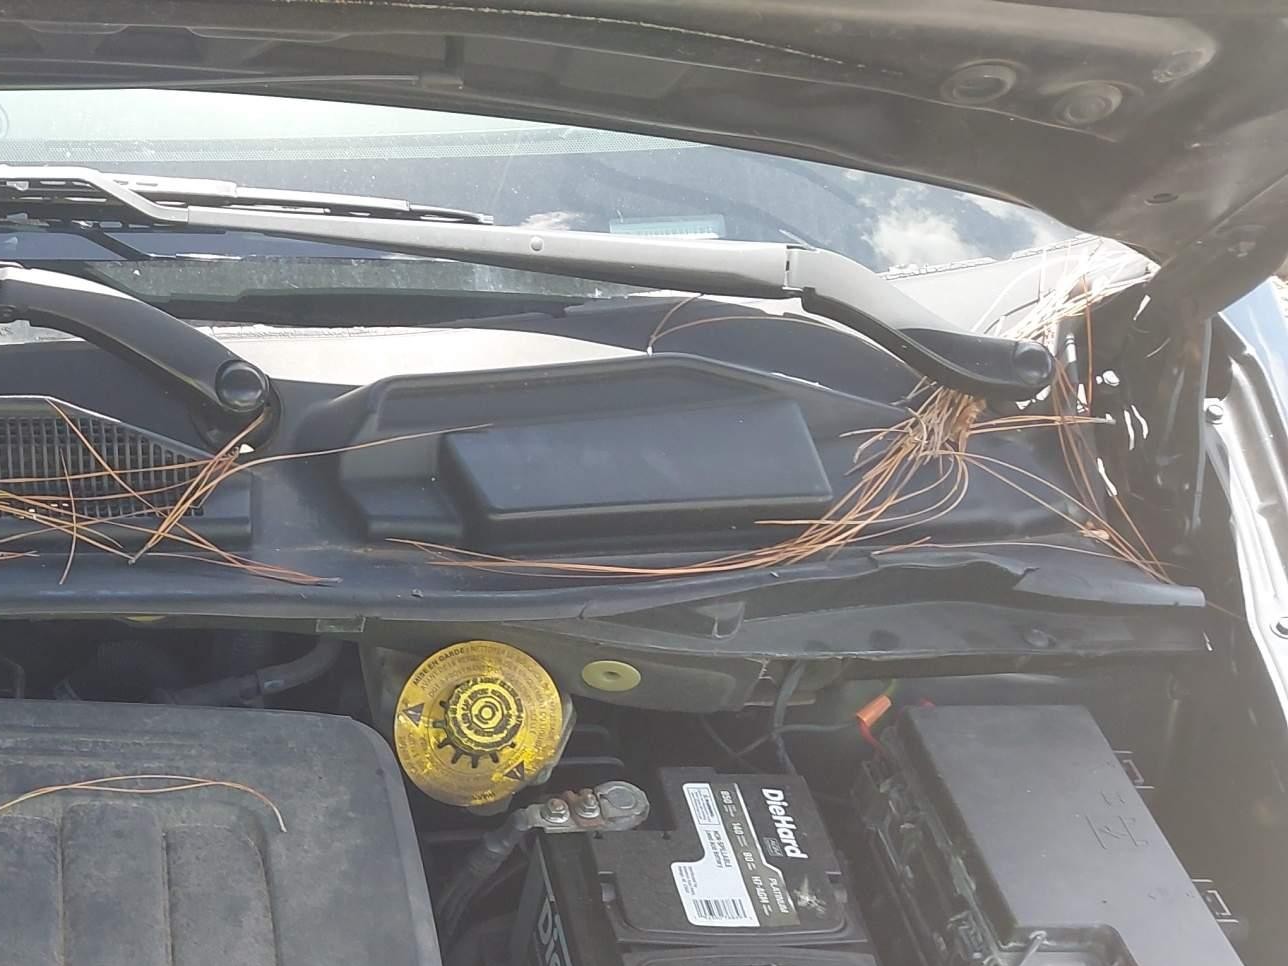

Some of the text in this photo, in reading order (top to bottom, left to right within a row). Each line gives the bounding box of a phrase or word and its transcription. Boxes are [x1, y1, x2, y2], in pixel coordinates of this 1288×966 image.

[438, 647, 465, 662] GARDE
[762, 789, 808, 858] DieHard
[732, 823, 744, 834] 140
[752, 876, 769, 904] H7-AGM
[769, 878, 789, 913] PLATINUM
